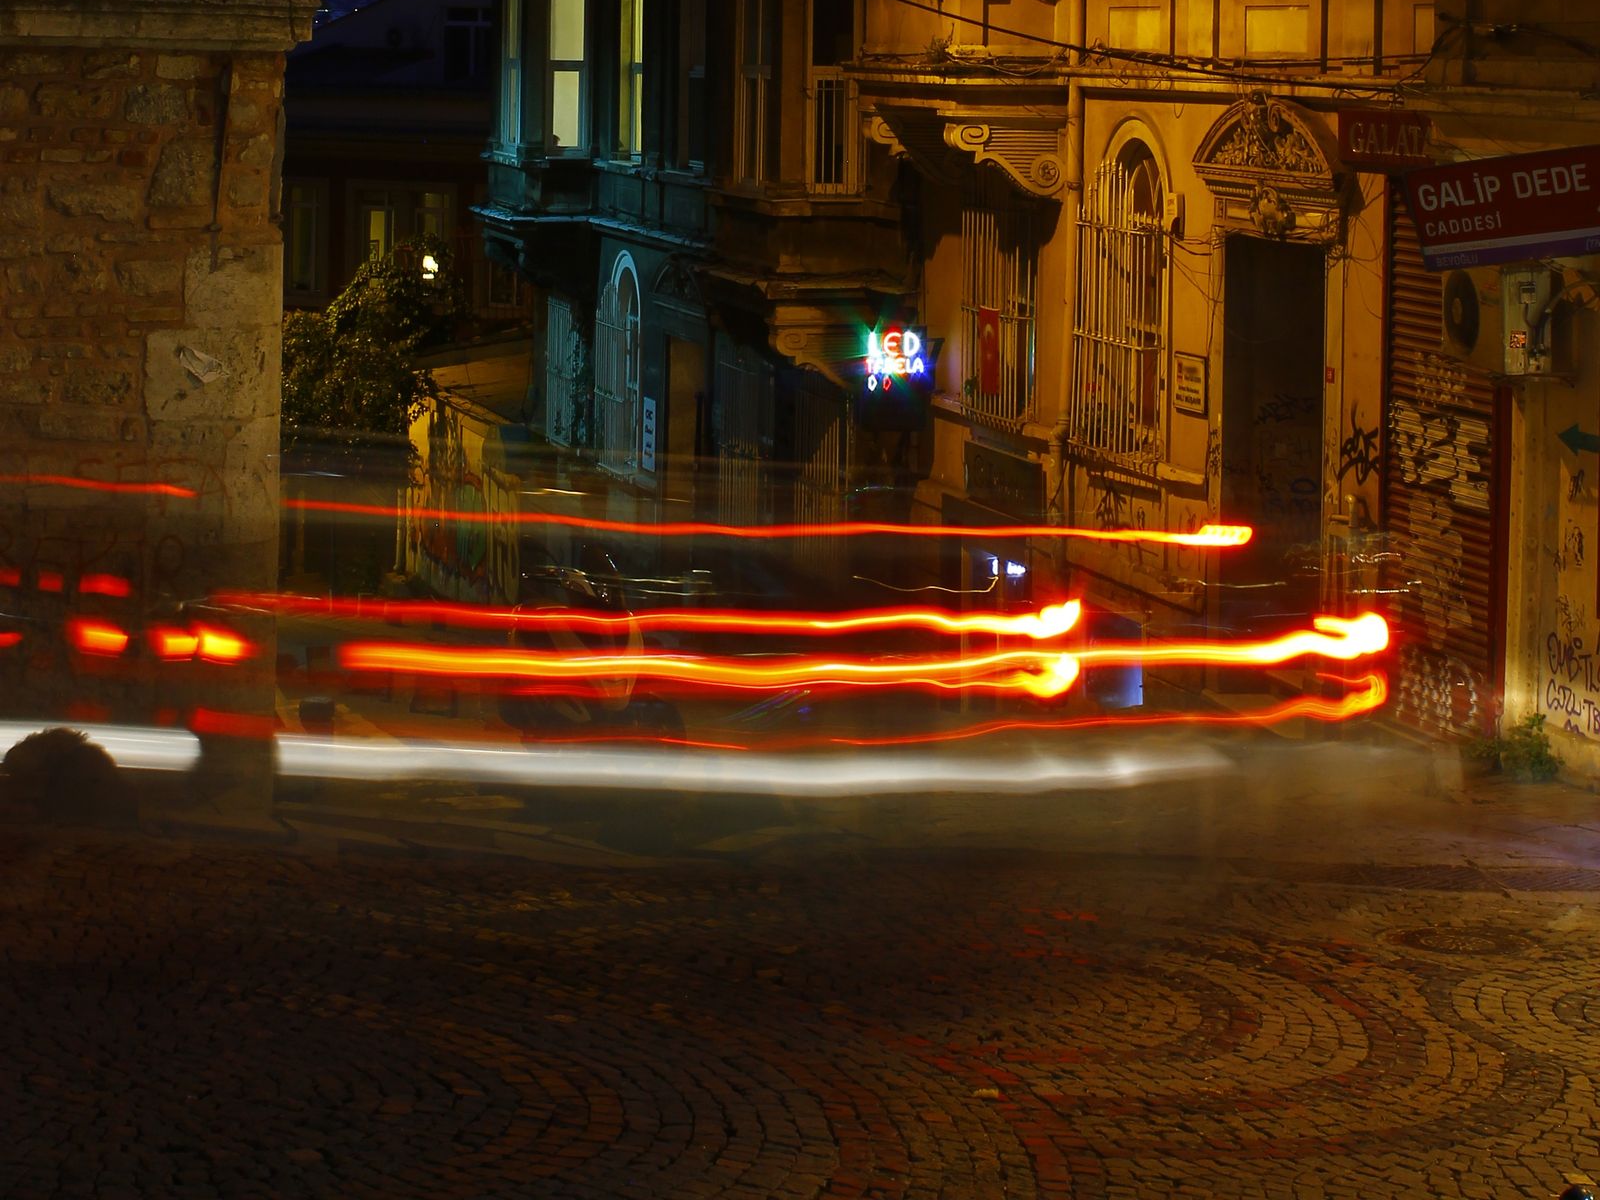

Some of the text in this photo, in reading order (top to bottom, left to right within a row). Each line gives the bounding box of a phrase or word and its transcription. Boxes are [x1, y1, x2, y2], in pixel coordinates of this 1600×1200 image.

[1418, 163, 1591, 212] GALİP DEDE
[1425, 210, 1502, 237] CADDESİ
[1435, 252, 1479, 268] BEYOĞLU
[867, 331, 921, 358] LED
